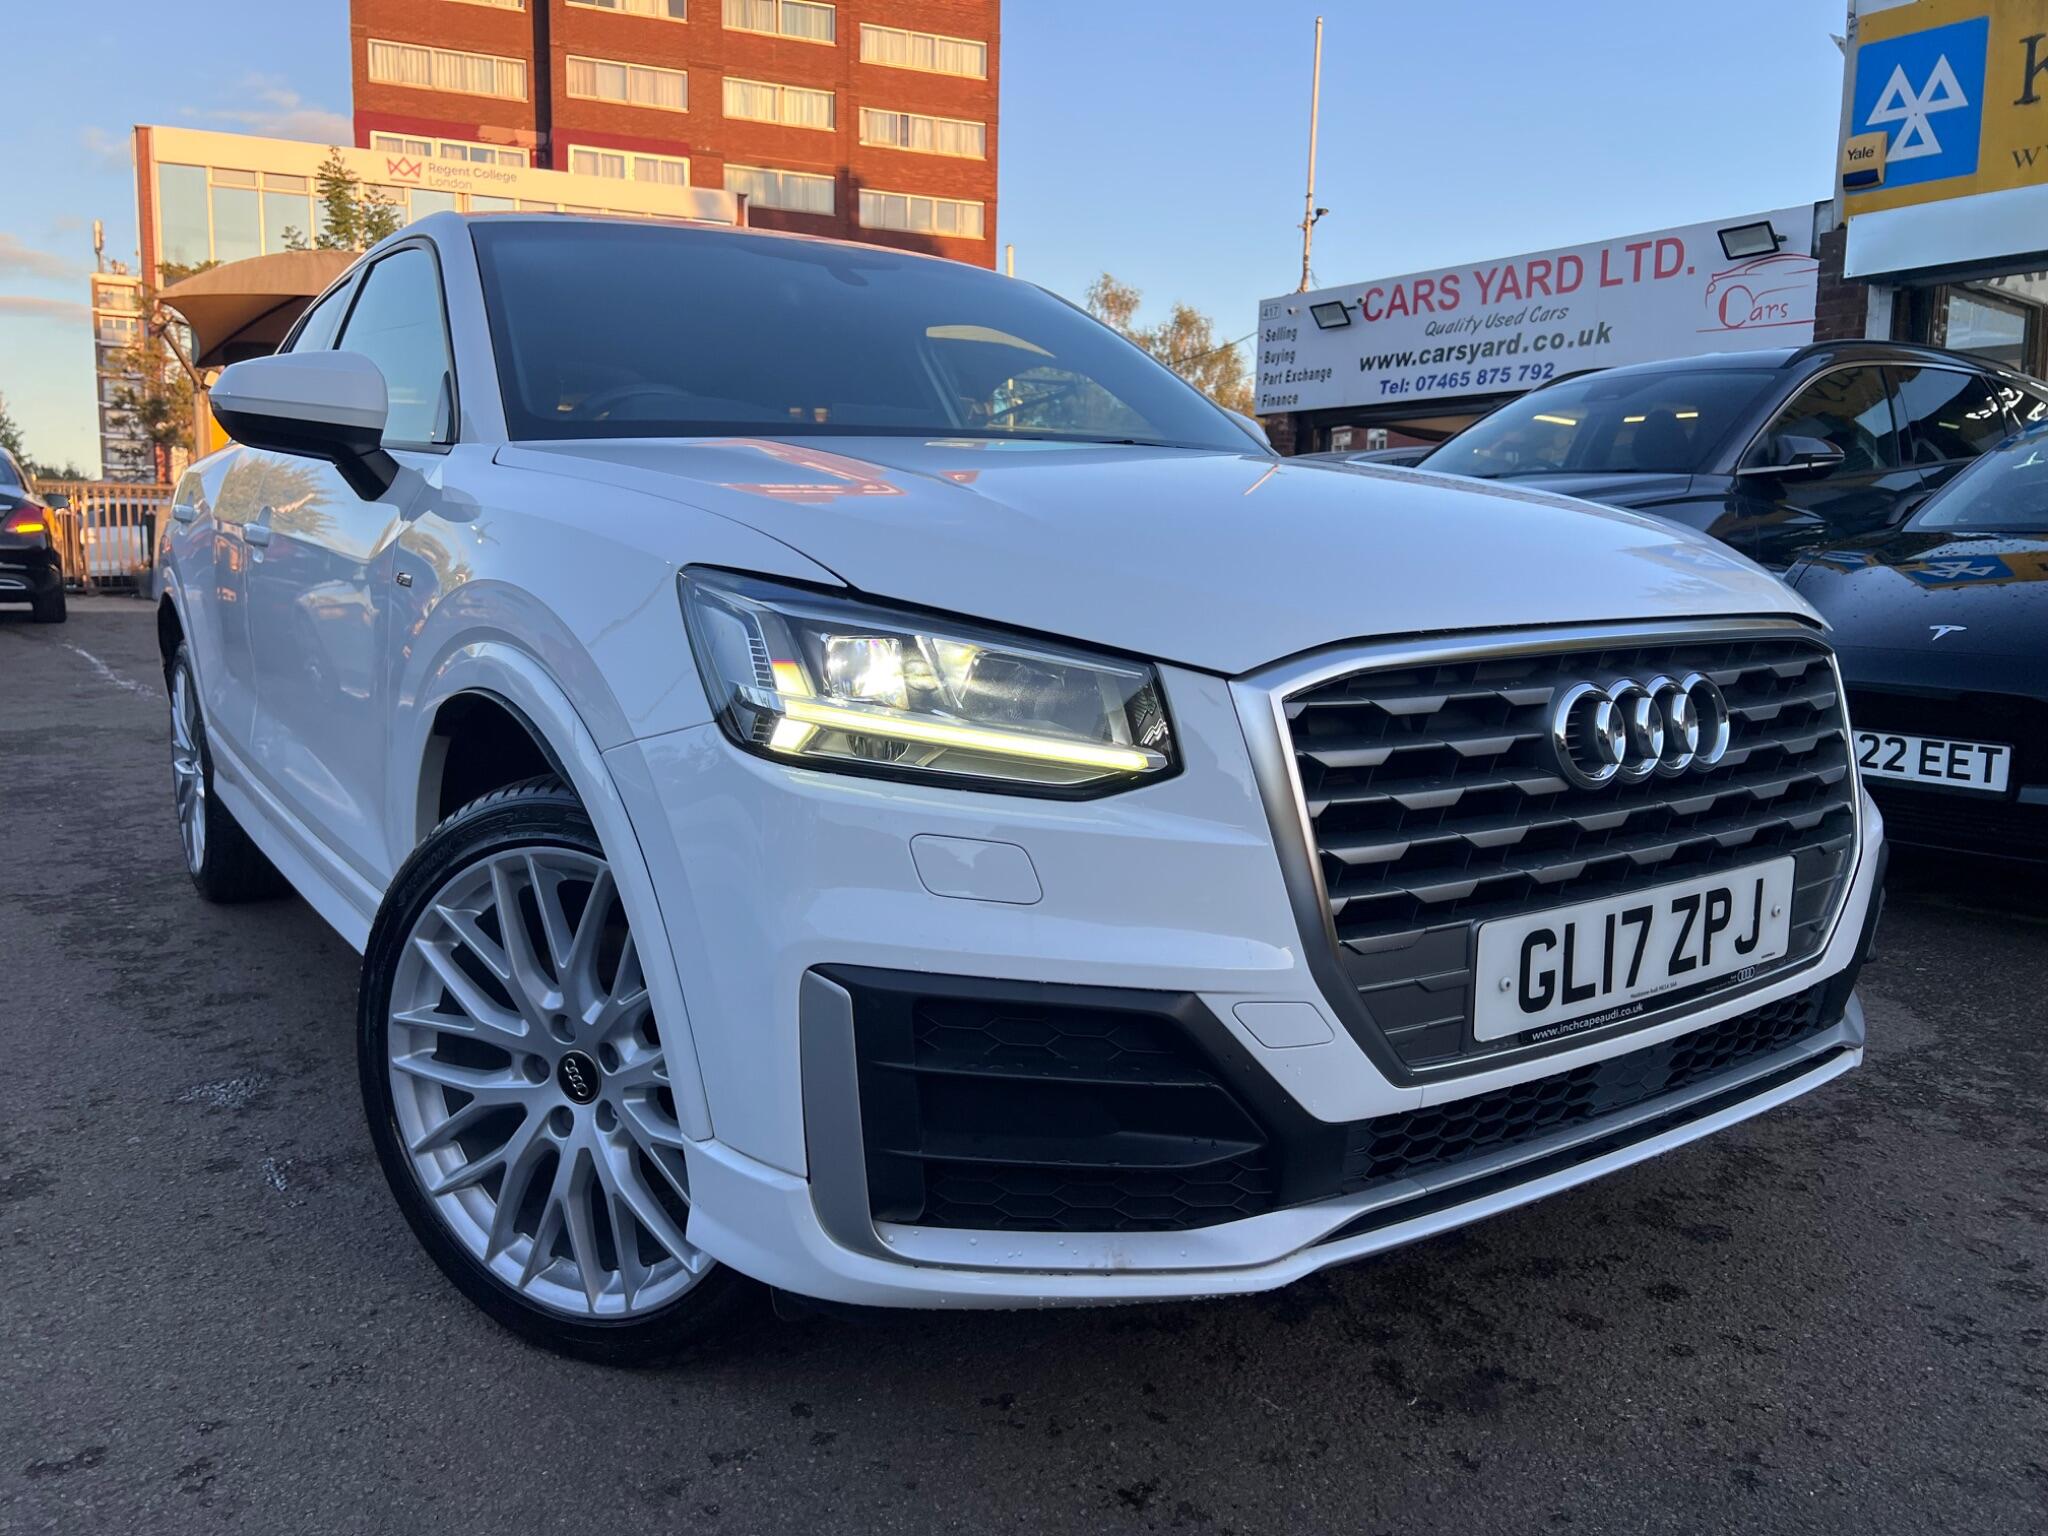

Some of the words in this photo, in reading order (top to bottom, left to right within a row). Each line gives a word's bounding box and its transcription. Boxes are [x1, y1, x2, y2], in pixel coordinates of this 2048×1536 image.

[1847, 147, 1875, 161] Yale
[428, 162, 471, 177] Regent
[473, 167, 518, 183] College
[428, 175, 472, 190] London
[1362, 274, 1461, 323] CARS
[1473, 255, 1584, 306] YARD
[1600, 237, 1695, 288] LTD.
[1263, 306, 1279, 317] 417
[1719, 284, 1789, 329] Cars
[1265, 326, 1298, 342] Selling
[1425, 315, 1484, 337] Quality
[1486, 307, 1527, 329] Used
[1529, 306, 1570, 323] Cars
[1264, 348, 1296, 366] Buying
[1360, 321, 1613, 372] www.carsyard.co.uk
[1262, 372, 1283, 385] Part
[1285, 368, 1332, 383] Exchange
[1380, 377, 1409, 395] Tel:
[1416, 372, 1471, 392] 07465
[1476, 366, 1511, 385] 875
[1519, 362, 1555, 381] 792
[1261, 393, 1299, 407] Finance
[1859, 733, 1907, 773] 22
[1918, 740, 2003, 783] EET
[1518, 905, 1653, 1014] GL17
[1668, 878, 1764, 977] ZPJ
[1532, 1003, 1644, 1041] www.inchcapeaudi.co.uk
